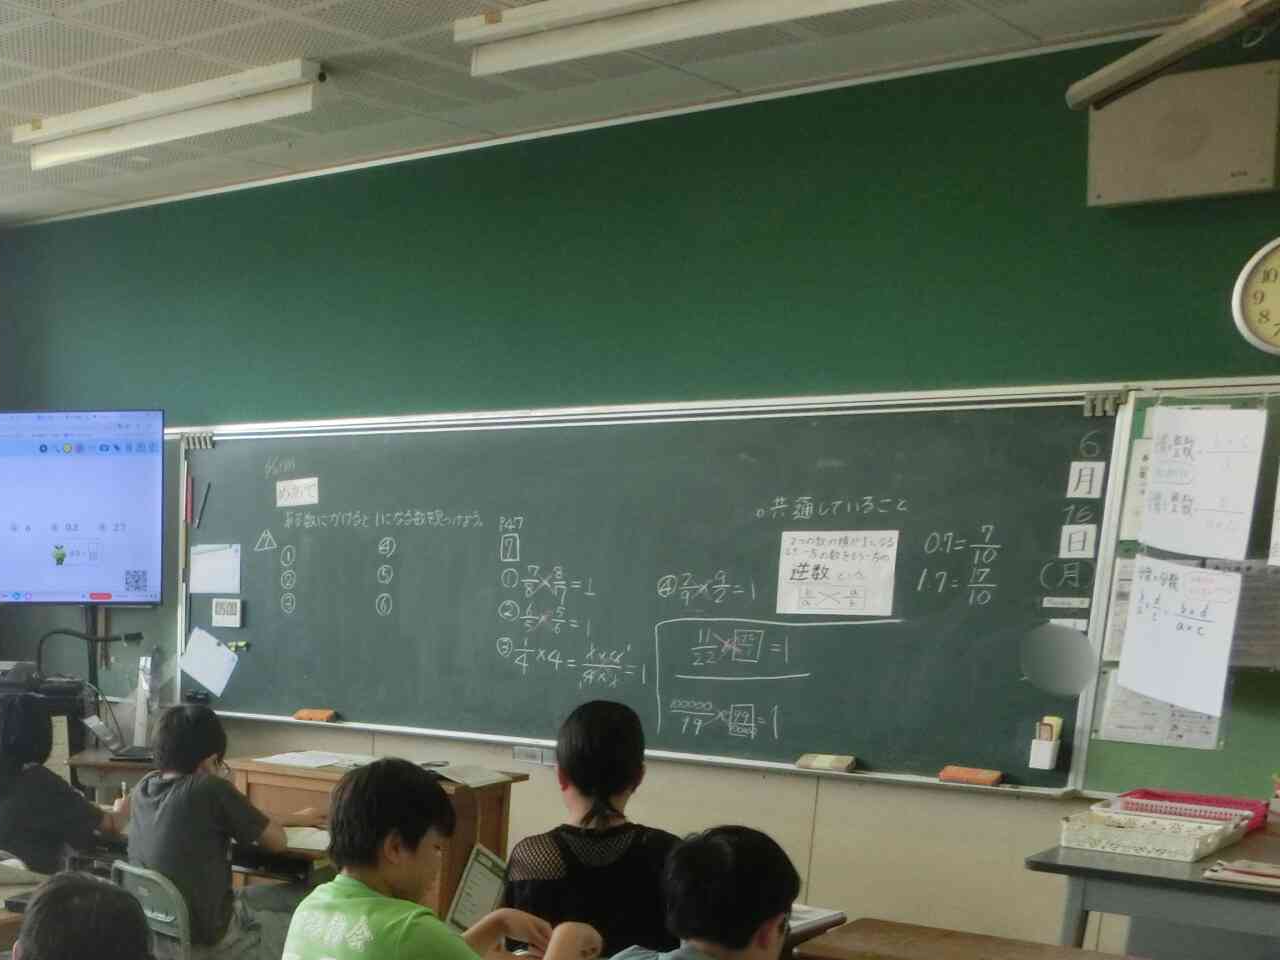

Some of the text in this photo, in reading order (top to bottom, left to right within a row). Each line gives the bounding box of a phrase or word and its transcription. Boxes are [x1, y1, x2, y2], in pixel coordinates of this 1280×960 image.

[1262, 266, 1278, 283] 10
[1253, 289, 1265, 305] 9
[1257, 309, 1271, 324] 8
[1080, 431, 1100, 457] 6
[1072, 466, 1096, 495] 月
[1067, 528, 1089, 552] 日
[789, 560, 830, 581] 逆数
